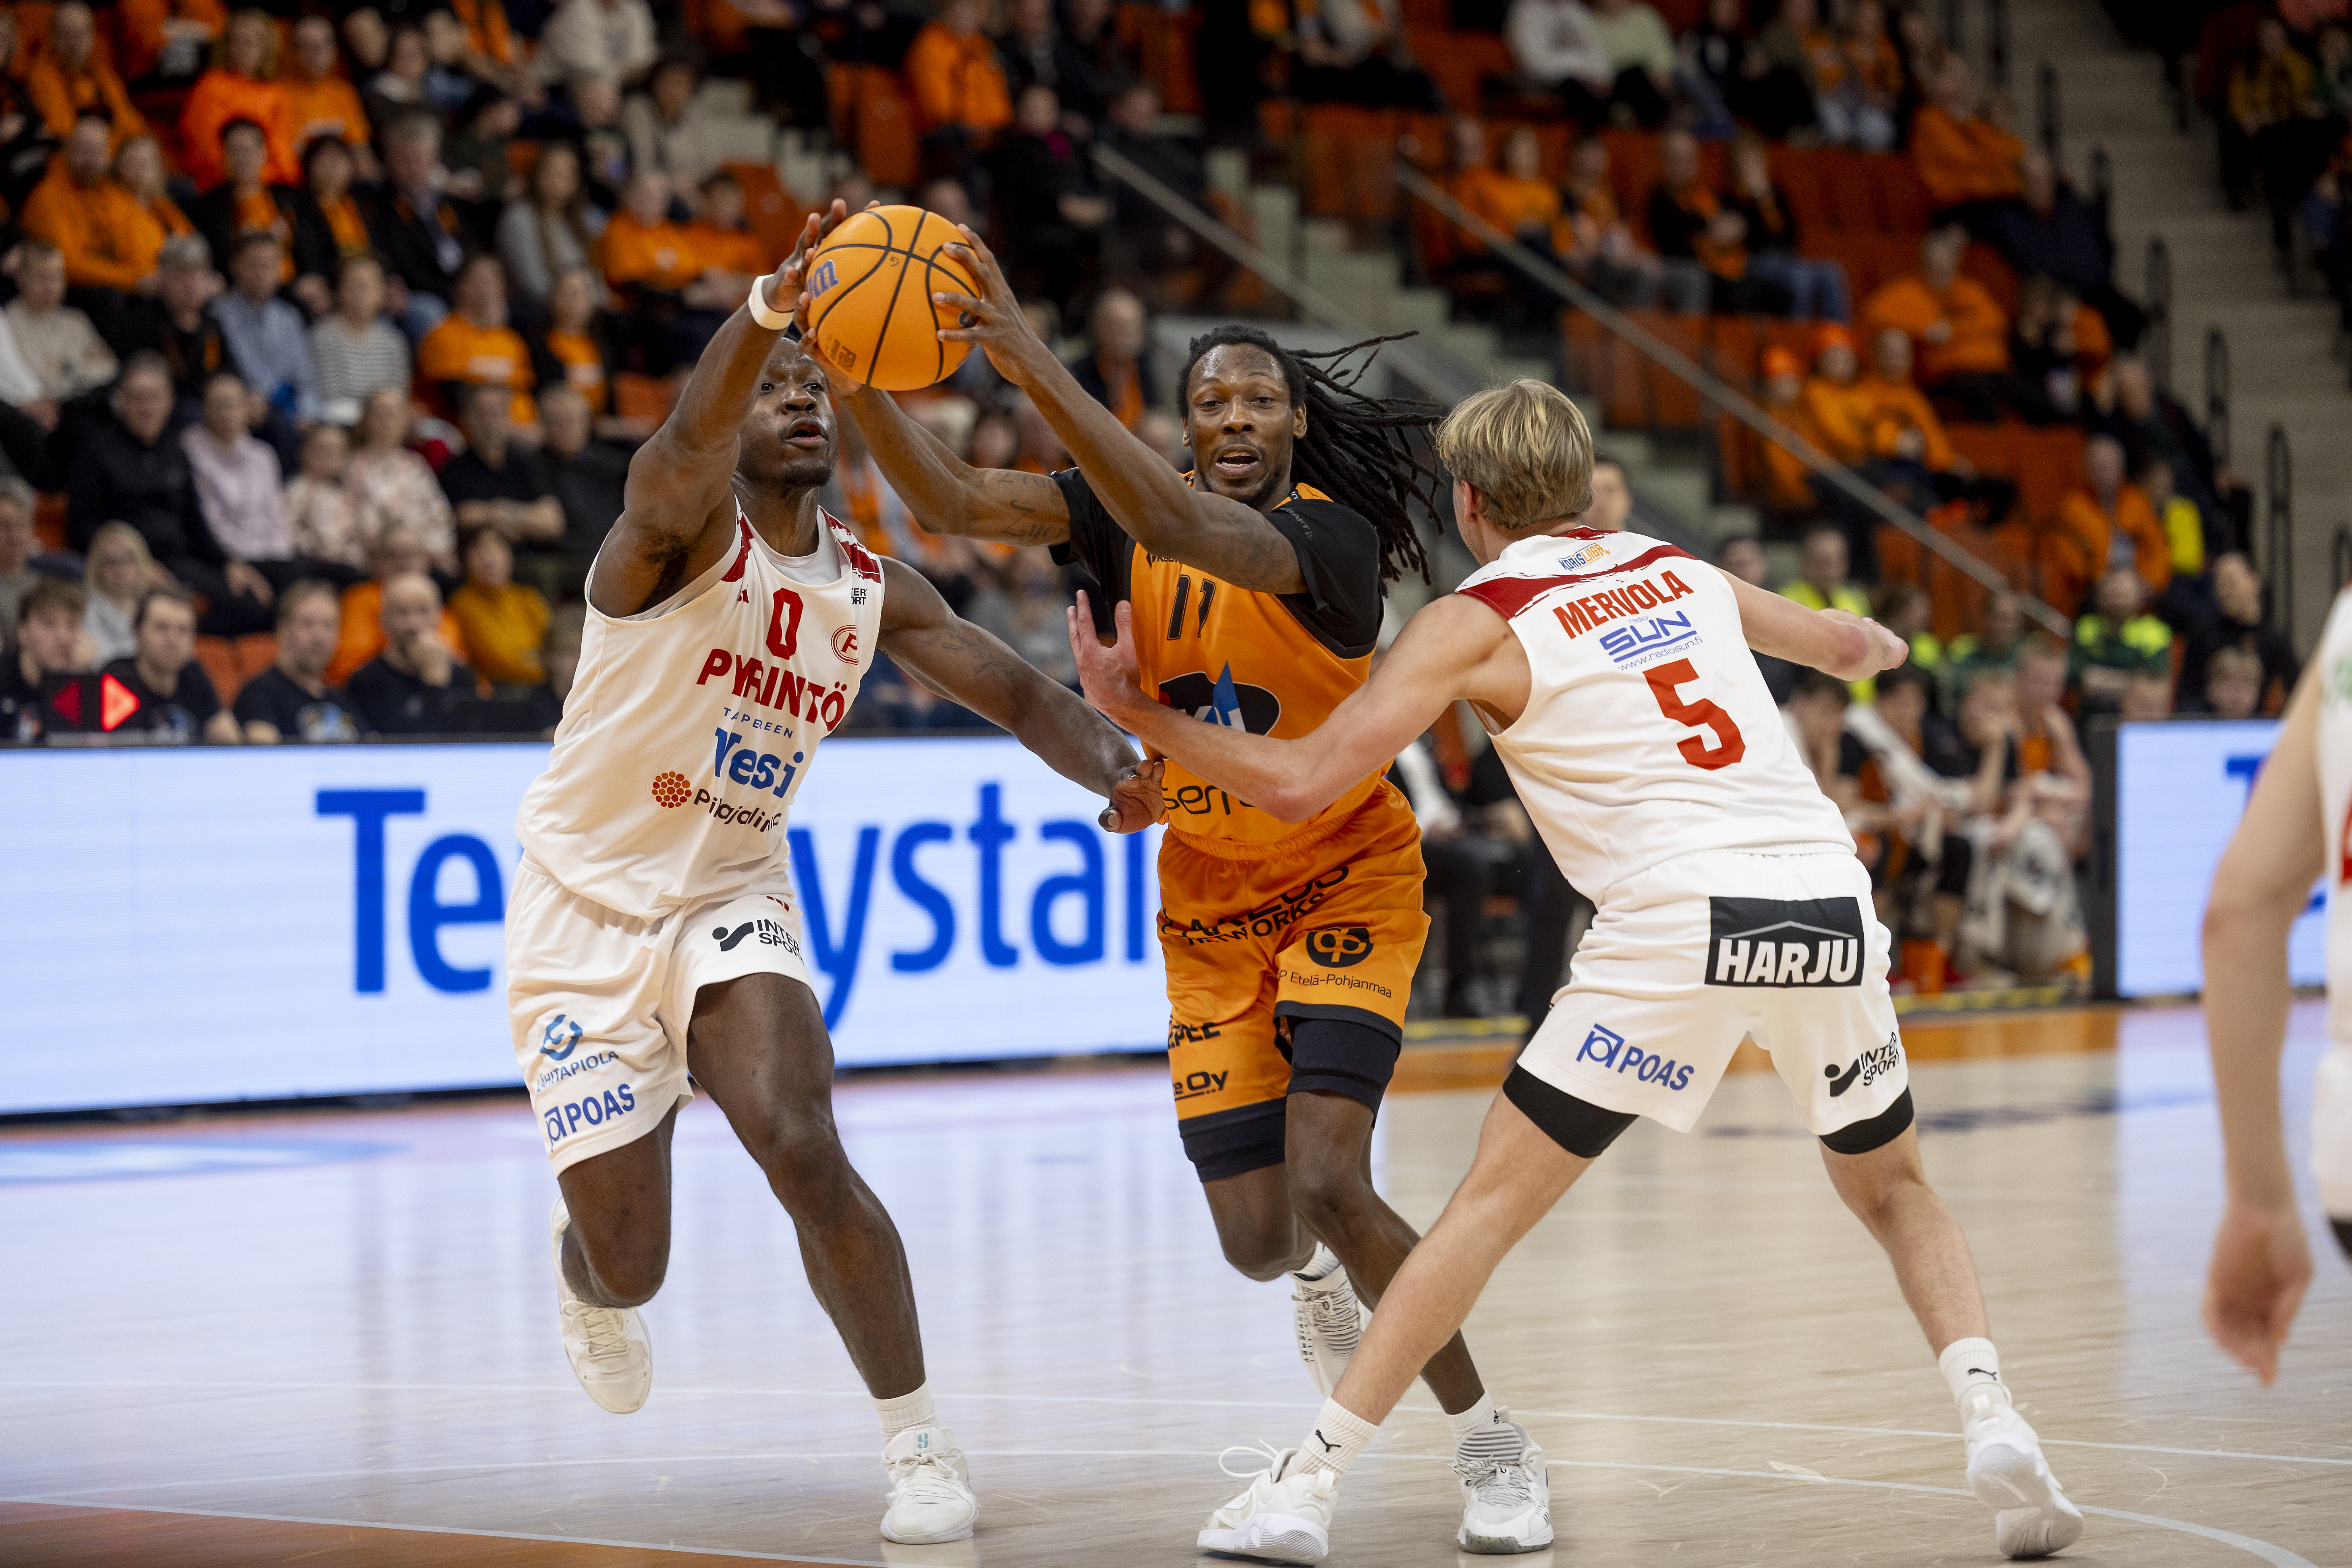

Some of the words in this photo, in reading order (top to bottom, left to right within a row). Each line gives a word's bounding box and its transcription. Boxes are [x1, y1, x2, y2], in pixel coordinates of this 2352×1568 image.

[766, 587, 804, 661] 0
[1167, 574, 1216, 641] 11
[1552, 570, 1694, 639] MERVOLA
[1599, 611, 1691, 656] SUN
[1618, 636, 1703, 670] www.radiosun.fi
[697, 649, 847, 732] PYRINTÖ
[724, 707, 793, 739] TAPEREEN
[1643, 658, 1746, 771] 5
[757, 919, 800, 954] INTER
[1715, 938, 1858, 984] HARJU
[1290, 971, 1392, 998] Etelä-Pohjanmaa
[1617, 1046, 1694, 1091] POAS
[1860, 1031, 1897, 1070] INTER
[1186, 1070, 1228, 1091] Oy
[564, 1083, 635, 1133] POAS
